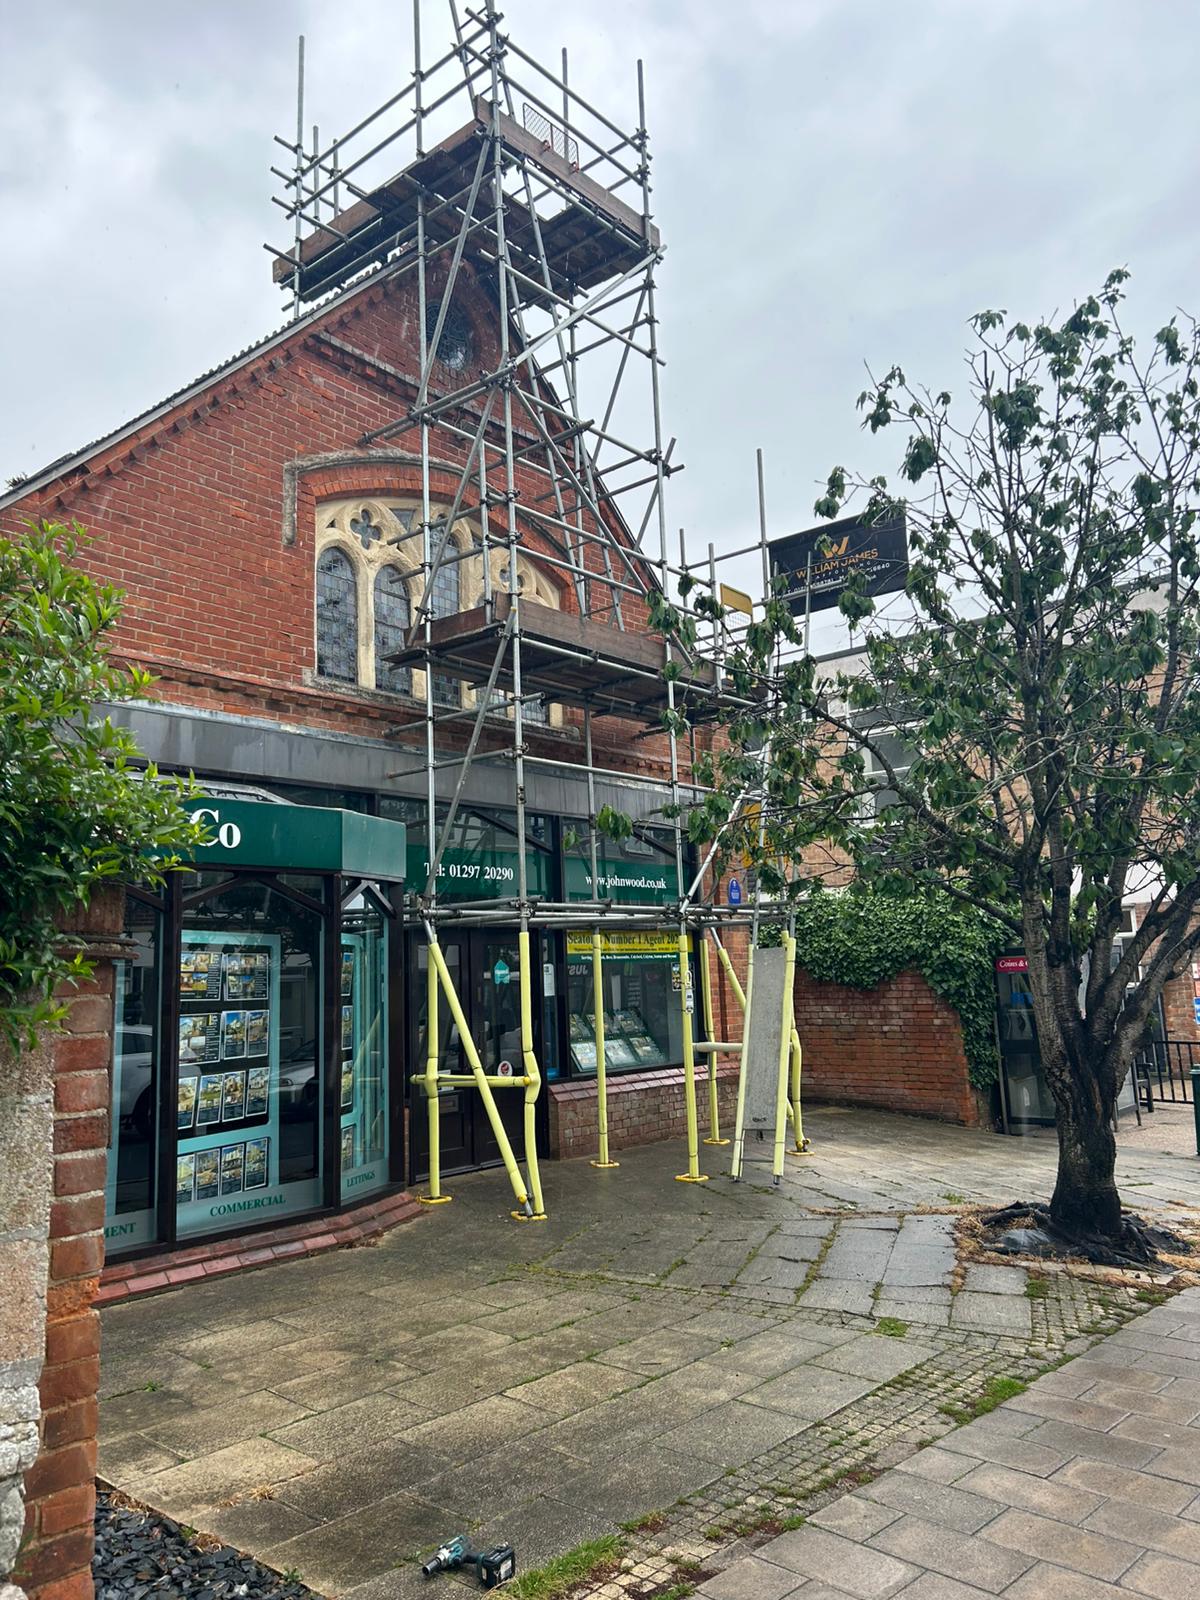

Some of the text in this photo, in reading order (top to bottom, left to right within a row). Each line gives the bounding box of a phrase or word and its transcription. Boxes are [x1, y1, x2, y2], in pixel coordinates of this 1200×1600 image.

[796, 548, 878, 579] WLIAM JAMES
[449, 864, 480, 878] 01297
[484, 866, 514, 880] 20290
[604, 932, 636, 945] Number
[210, 1194, 286, 1217] COMMERCIAL
